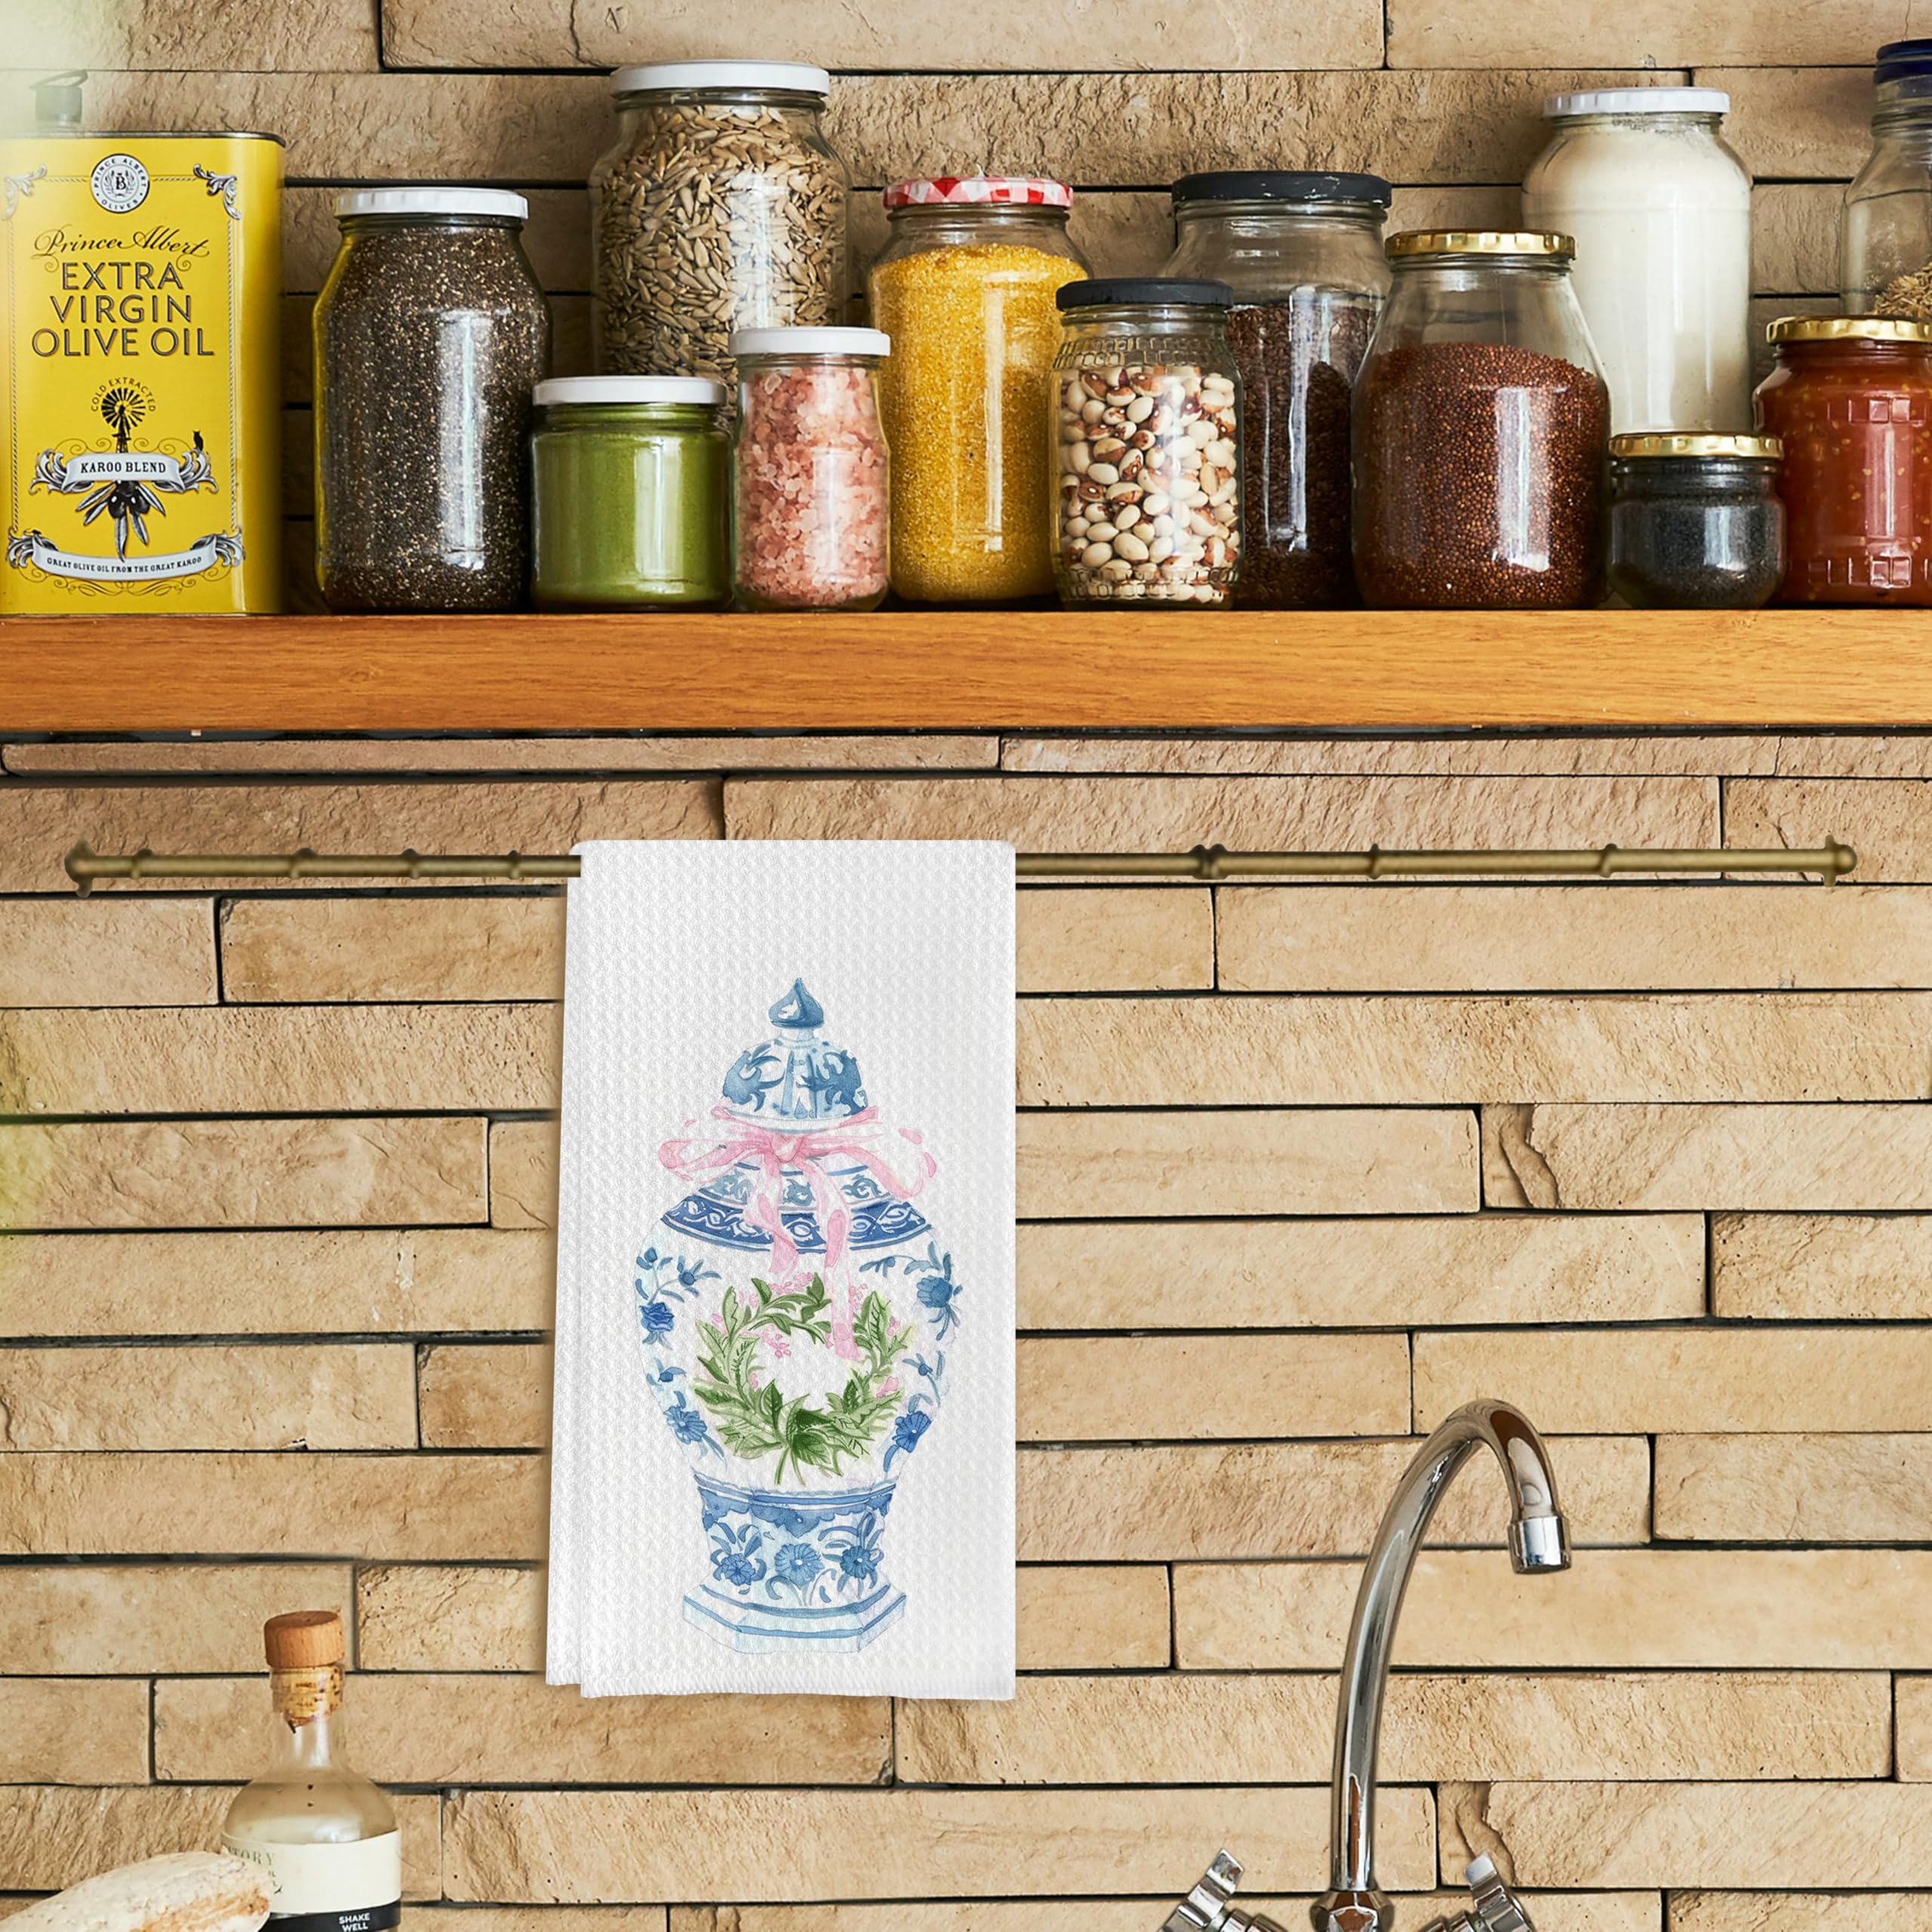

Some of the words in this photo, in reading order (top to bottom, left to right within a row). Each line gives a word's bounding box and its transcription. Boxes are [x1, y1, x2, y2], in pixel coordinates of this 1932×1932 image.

[94, 158, 115, 188] PRINCE
[122, 158, 146, 187] ALBERT
[101, 199, 138, 210] OLIVES
[31, 224, 123, 259] Prince
[132, 225, 210, 259] Albert
[62, 262, 183, 290] EXTRA
[50, 294, 191, 323] VIRGIN
[32, 328, 139, 357] OLIVE
[151, 328, 214, 356] OIL
[91, 385, 106, 412] COLD
[108, 377, 156, 412] EXTRACTED
[81, 462, 122, 473] KAROO
[125, 462, 166, 473] BLEND
[47, 557, 72, 568] GREAT
[73, 562, 96, 571] OLIVE
[150, 562, 175, 571] GREAT
[177, 556, 202, 568] KAROO
[339, 1912, 371, 1924] SHAKE
[342, 1921, 369, 1932] WELL
